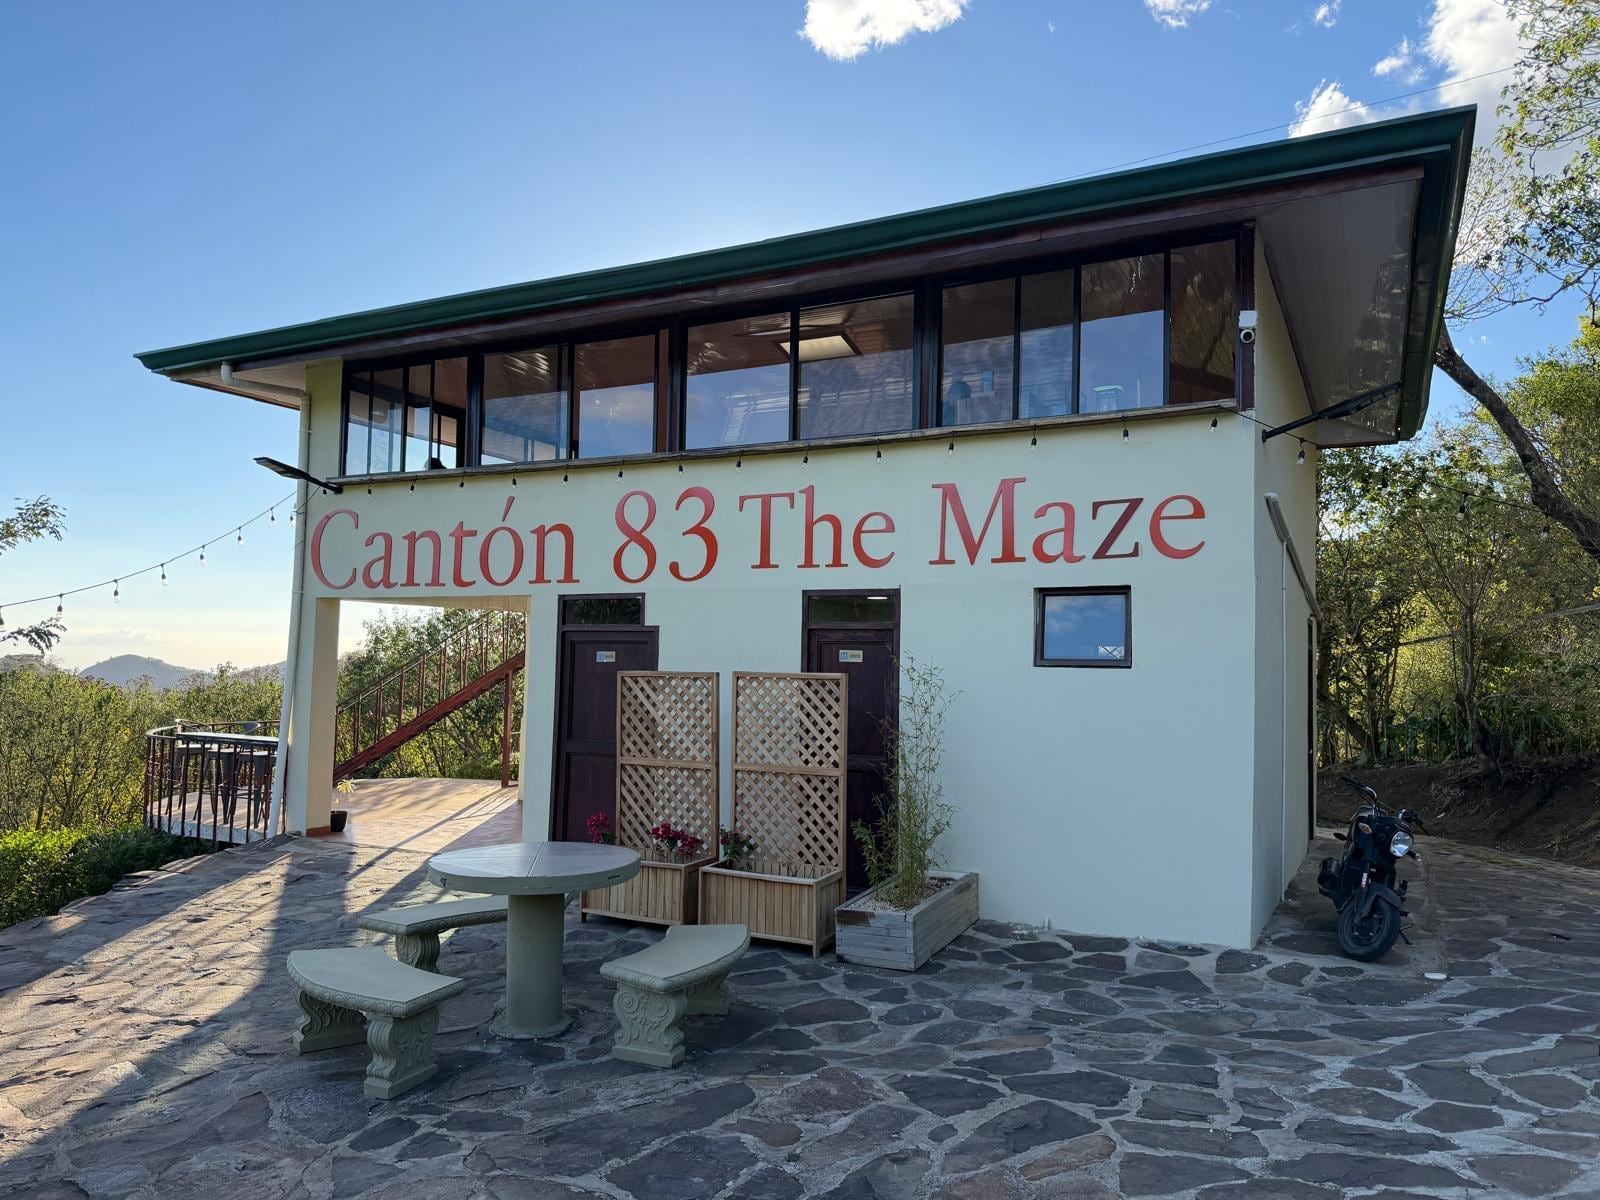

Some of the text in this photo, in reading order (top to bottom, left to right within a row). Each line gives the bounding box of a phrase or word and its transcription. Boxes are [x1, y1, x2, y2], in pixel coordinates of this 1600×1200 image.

[311, 477, 1206, 589] Cantón 83 The Maze
